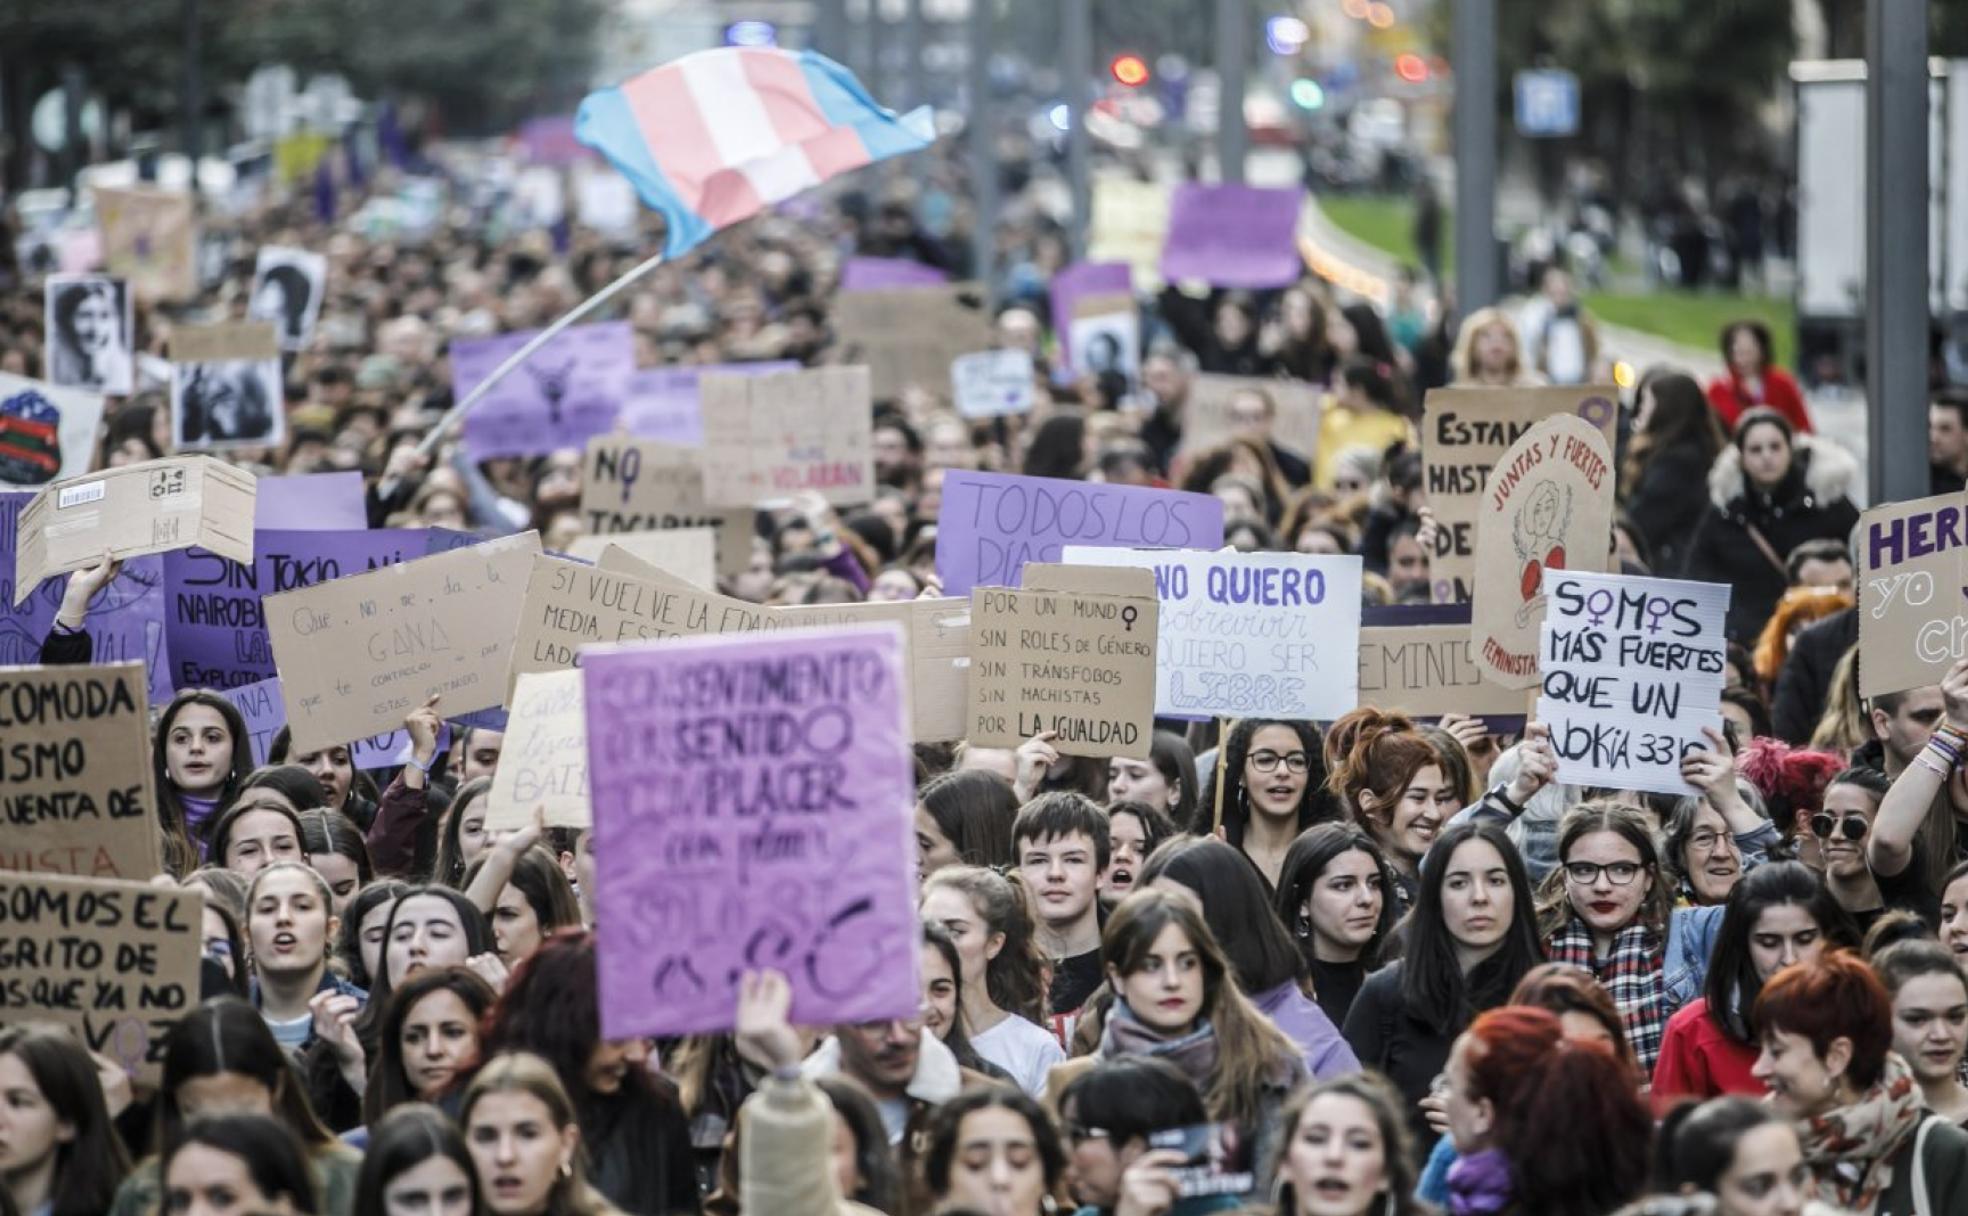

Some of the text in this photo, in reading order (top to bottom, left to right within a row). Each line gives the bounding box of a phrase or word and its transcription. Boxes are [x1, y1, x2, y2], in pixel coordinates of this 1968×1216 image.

[1493, 434, 1608, 512] JUNTAS Y FUERTES
[960, 482, 1191, 547] TODOS LOS
[1436, 523, 1472, 557] DE
[1869, 507, 1968, 570] HER
[184, 545, 257, 590] SIN
[1154, 564, 1325, 606] NO QUIERO
[552, 567, 576, 594] SI
[590, 576, 678, 625] VUELVE
[687, 599, 708, 632] LA
[984, 592, 1018, 615] POR
[1035, 596, 1056, 616] UN
[292, 606, 331, 636] Que
[368, 618, 449, 662] GANA
[235, 630, 268, 664] LA
[980, 629, 1006, 647] SIN
[1021, 629, 1070, 652] ROLES
[1097, 634, 1150, 657] GÉNERO
[1158, 635, 1319, 673] QUIERO SER
[1551, 626, 1723, 674] MÁS FUERTES
[979, 659, 1122, 685] SIN TRÁNSFOBOS
[979, 687, 1101, 705] SIN MACHISTAS
[1170, 671, 1306, 714] LIBRE
[1544, 670, 1681, 719] QUE UN
[978, 712, 1138, 744] POR LA IGUALDAD
[0, 785, 143, 825] UENTA DE
[134, 894, 189, 932] EL
[115, 943, 157, 975] DE
[32, 976, 86, 1011] QUE
[93, 976, 125, 1010] YA
[139, 982, 186, 1010] NO
